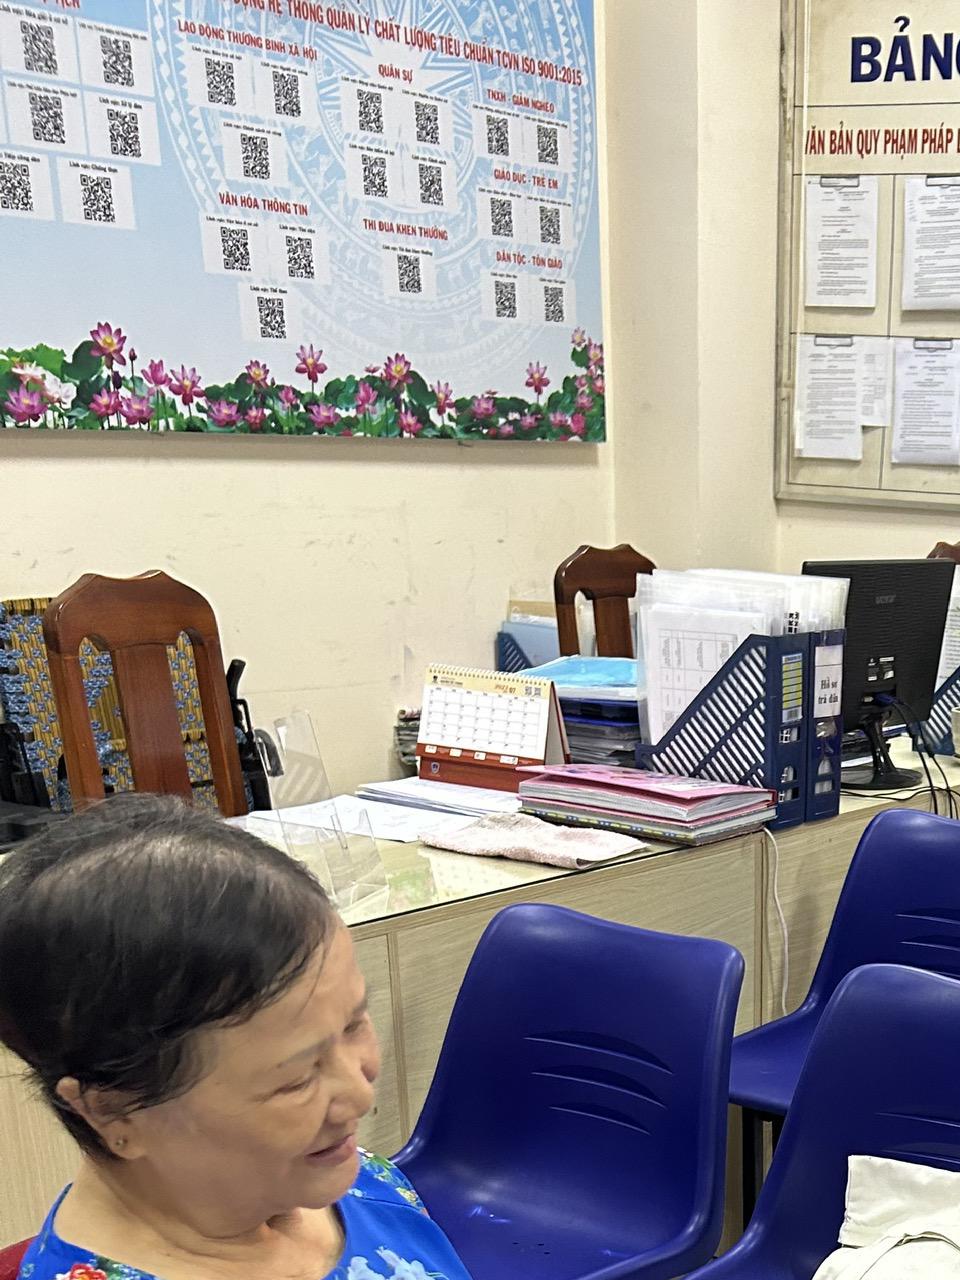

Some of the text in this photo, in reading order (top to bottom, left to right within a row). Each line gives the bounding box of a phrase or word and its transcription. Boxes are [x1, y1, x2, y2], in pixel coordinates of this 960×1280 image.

[178, 19, 196, 34] LAO
[265, 38, 286, 53] BINH
[327, 4, 355, 32] QUẢN
[359, 12, 370, 35] LÝ
[375, 16, 400, 42] CHẤT
[404, 26, 436, 52] LƯỢNG
[439, 33, 460, 57] TIÊU
[464, 37, 494, 65] CHUẨN
[496, 50, 519, 71] TCVN
[522, 55, 535, 74] ISO
[538, 60, 582, 86] 9001:2015
[830, 121, 852, 154] BẢN
[857, 129, 880, 159] QUY
[884, 129, 918, 159] PHẠM
[921, 122, 953, 154] PHÁP
[219, 191, 307, 216] VĂN HÓA THÔNG TIN
[363, 219, 376, 230] THI
[379, 221, 394, 233] ĐUA
[396, 224, 416, 236] KHEN
